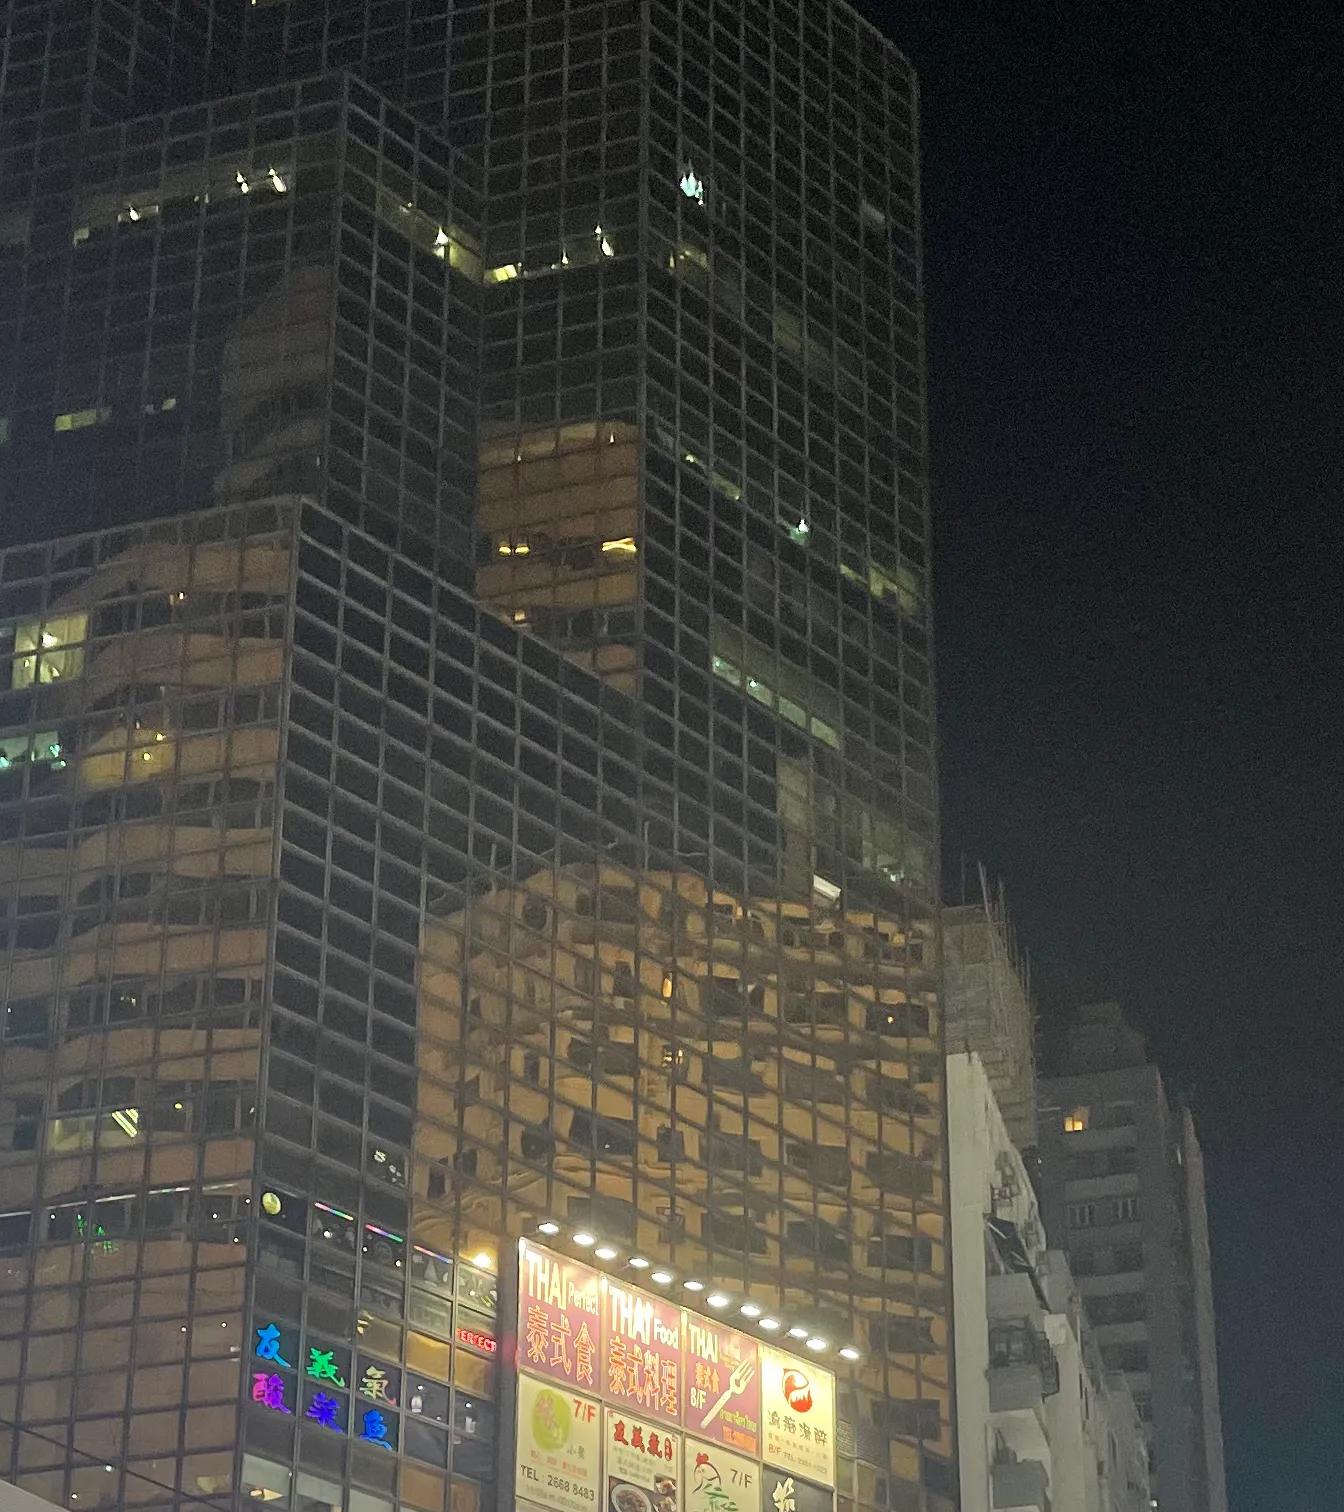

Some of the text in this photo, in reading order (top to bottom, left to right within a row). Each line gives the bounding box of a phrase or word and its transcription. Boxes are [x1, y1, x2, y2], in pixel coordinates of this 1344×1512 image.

[524, 1252, 567, 1311] THAI
[609, 1284, 680, 1350] THAI Food
[573, 1398, 596, 1423] 7/F
[730, 1467, 753, 1489] 7/F
